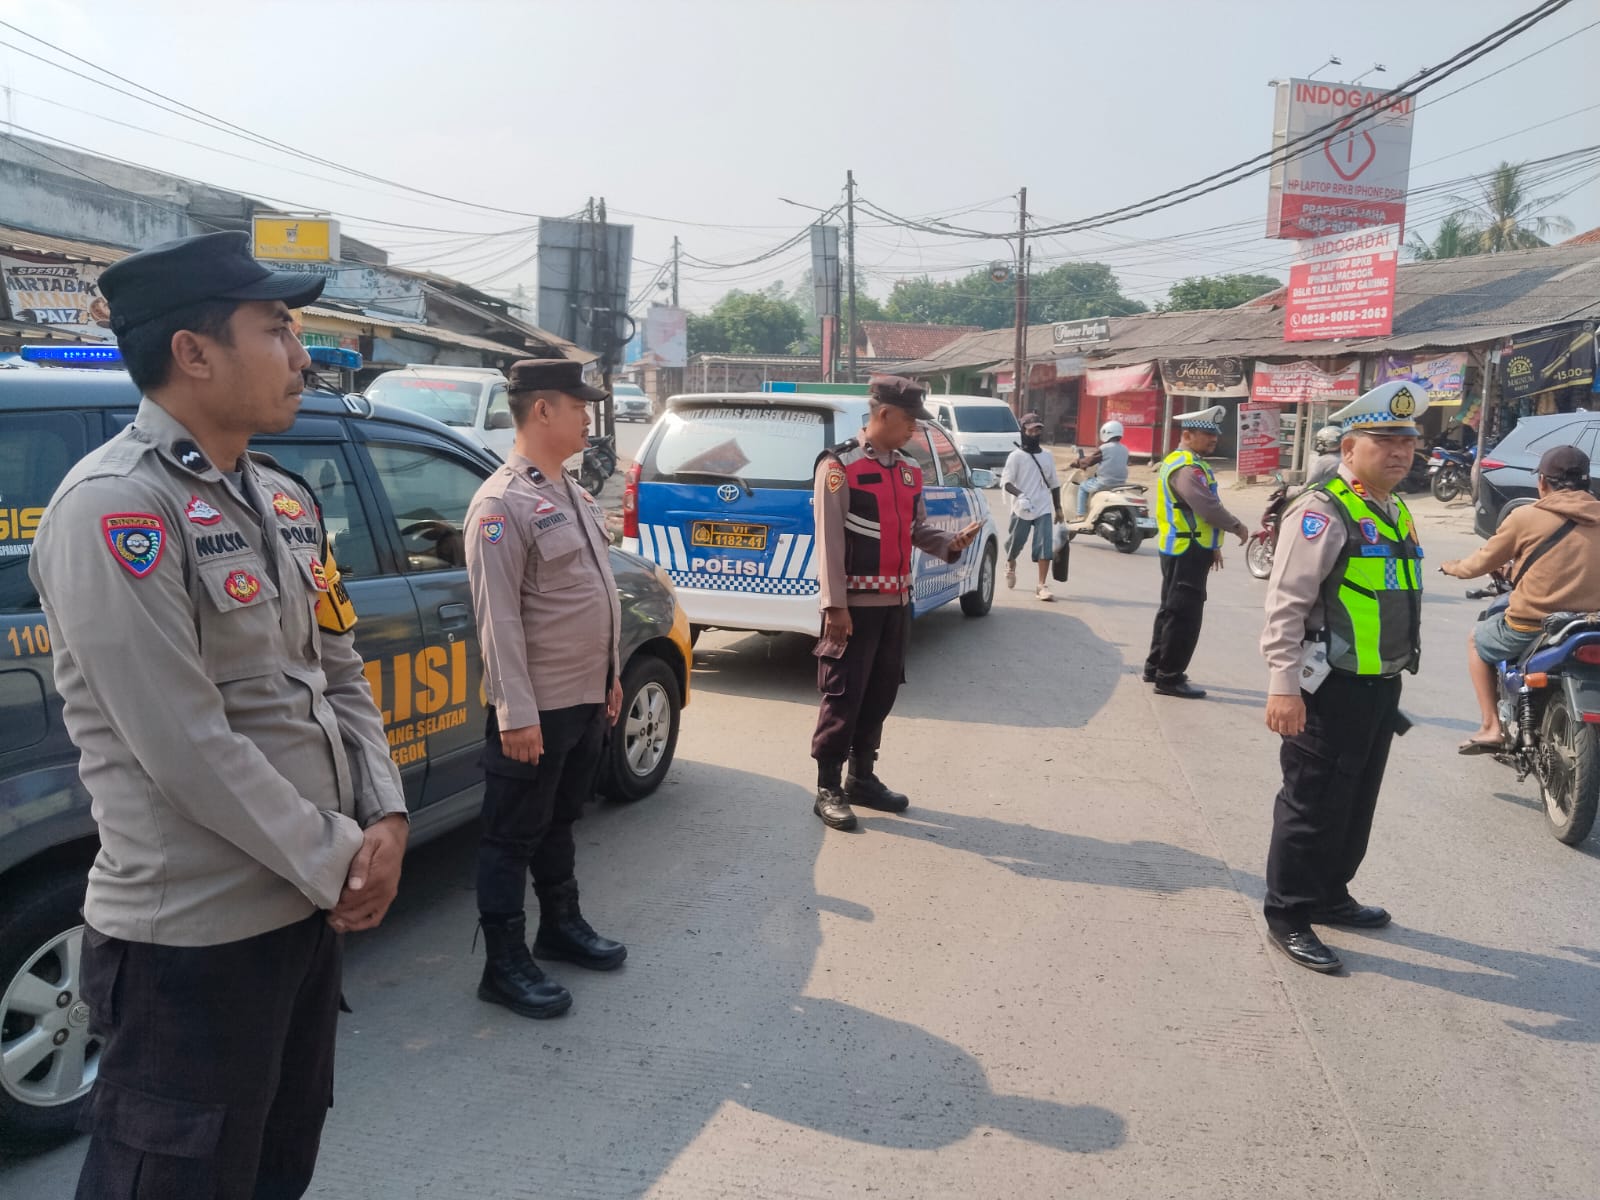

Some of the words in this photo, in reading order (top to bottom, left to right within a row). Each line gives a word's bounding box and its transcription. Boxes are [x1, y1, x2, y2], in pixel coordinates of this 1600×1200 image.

[1296, 84, 1411, 113] INDOGADAI
[1288, 179, 1299, 190] HP
[1301, 181, 1331, 193] LAPTOP
[1333, 184, 1353, 195] BPKB
[1312, 232, 1389, 256] INDOGADAI
[18, 267, 72, 277] SPESIAL
[6, 277, 97, 296] MARTABAK
[1328, 281, 1356, 293] LAPTOP
[1357, 277, 1389, 290] GAMING
[703, 409, 741, 421] LANTAS
[742, 409, 783, 422] POLSEK
[784, 411, 823, 425] LEGOK
[110, 519, 157, 528] BINMAS
[732, 525, 749, 533] VII
[195, 531, 249, 557] MULYA
[715, 535, 762, 547] 1182-41
[8, 624, 51, 656] 110
[416, 706, 467, 738] SELATAN
